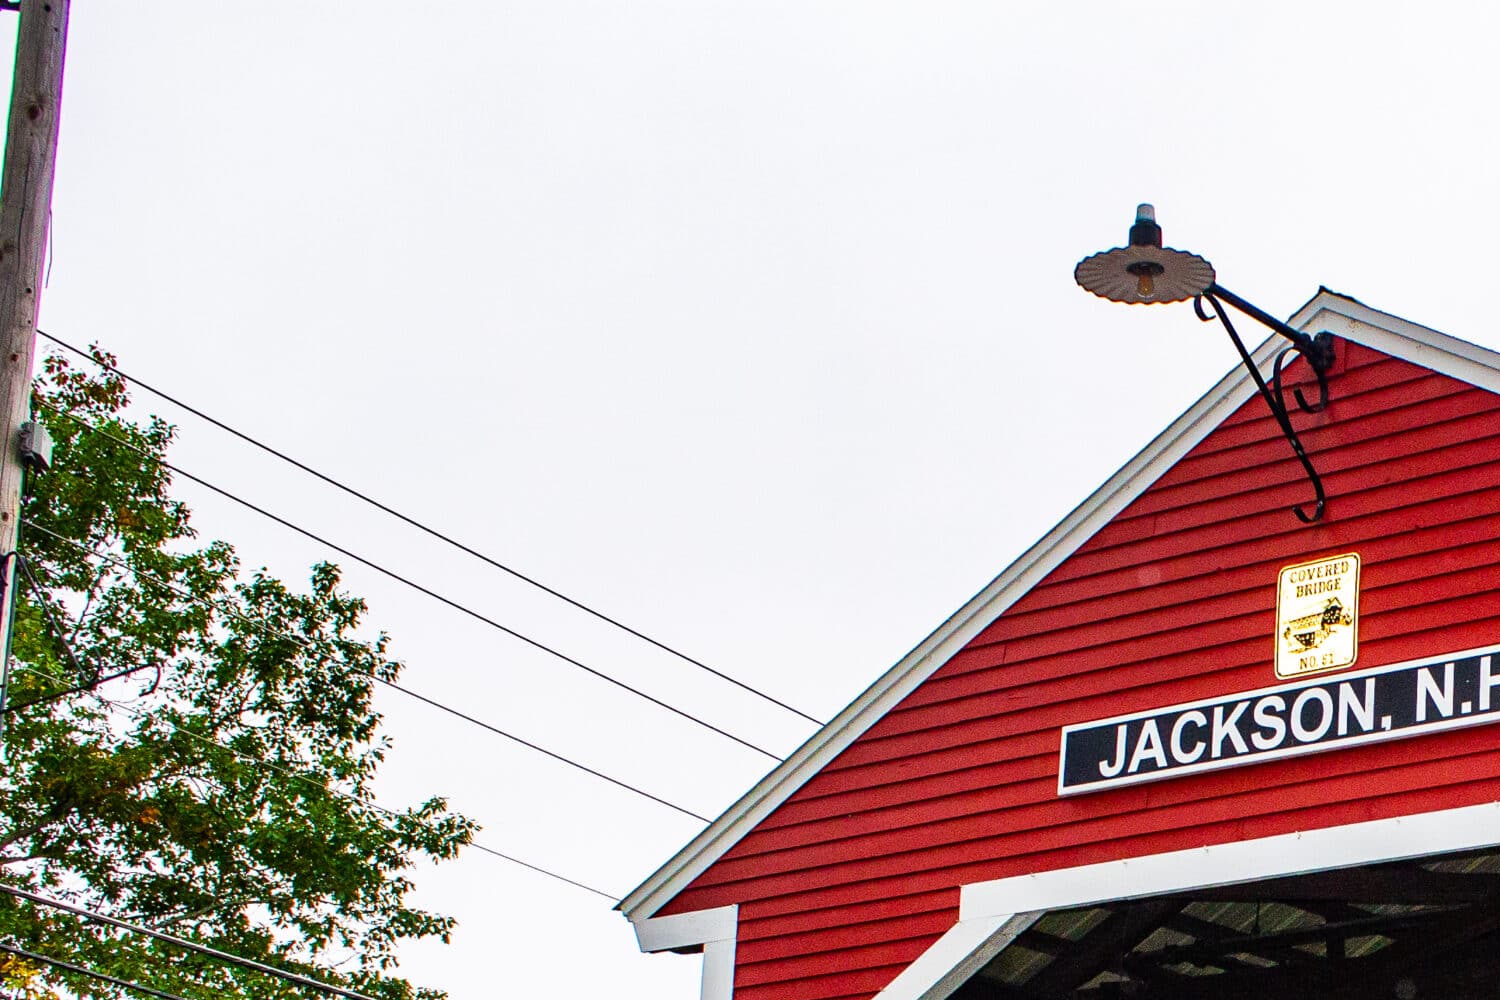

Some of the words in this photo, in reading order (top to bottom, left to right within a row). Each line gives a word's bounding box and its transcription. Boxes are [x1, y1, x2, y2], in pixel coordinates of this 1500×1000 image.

[1289, 561, 1350, 584] COVERED
[1296, 577, 1342, 598] BRIDGE
[1099, 678, 1393, 778] JACKSON,
